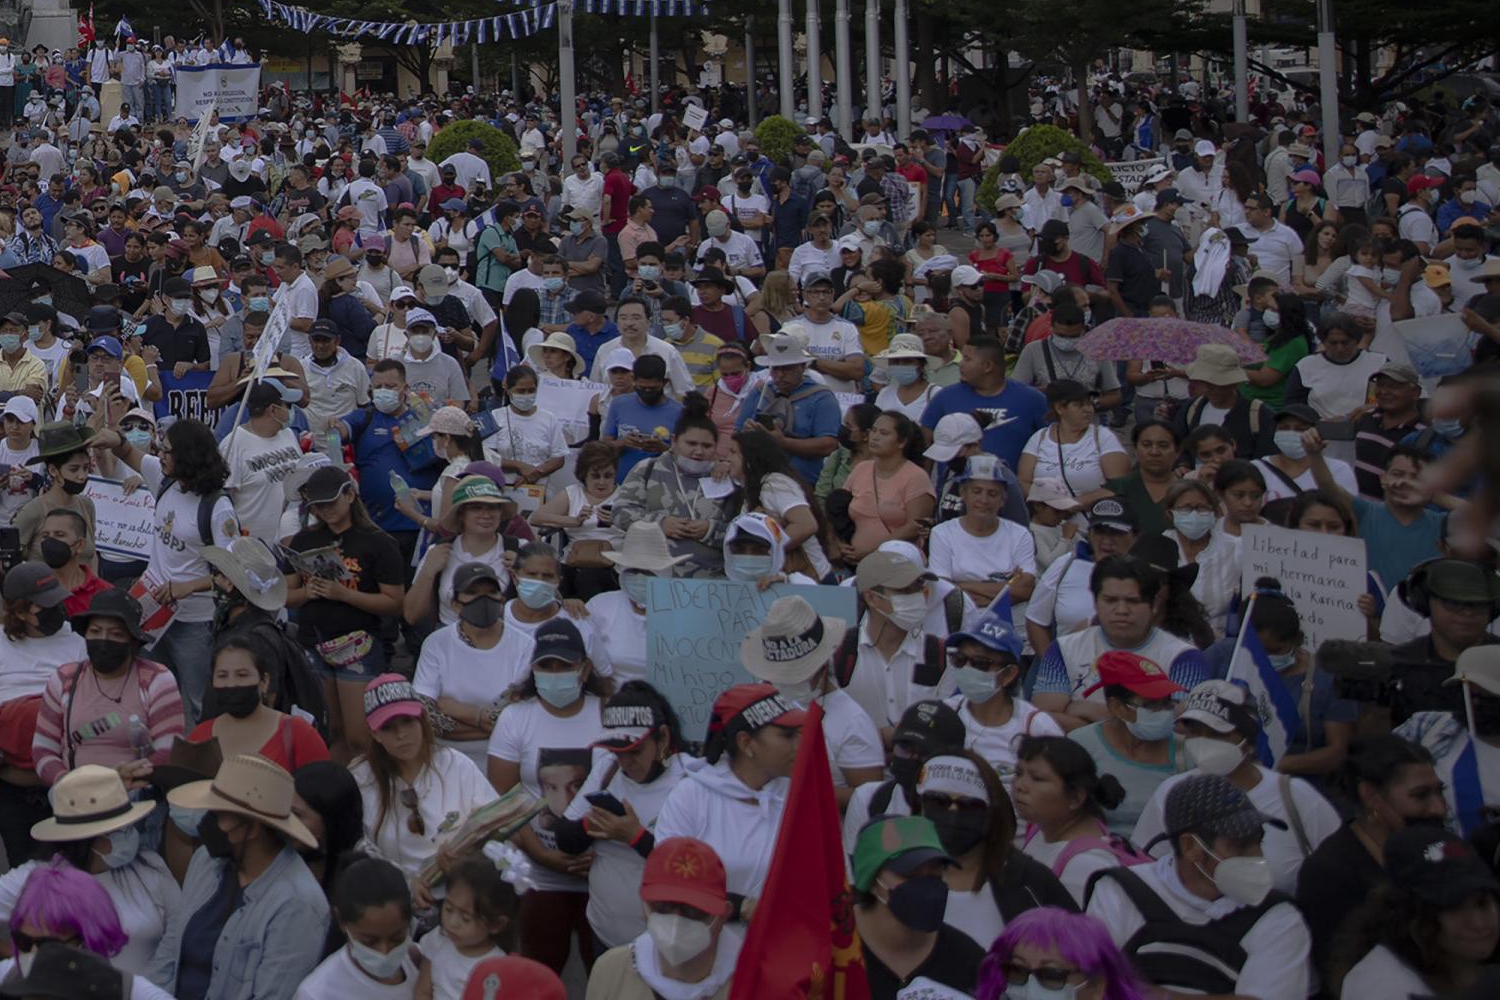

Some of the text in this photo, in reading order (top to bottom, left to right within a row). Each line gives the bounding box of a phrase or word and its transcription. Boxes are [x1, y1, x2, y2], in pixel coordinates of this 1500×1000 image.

[1111, 164, 1146, 172] LICTO
[1252, 535, 1359, 569] Libertad para
[1252, 562, 1269, 574] mi
[716, 608, 761, 635] PAR
[654, 631, 741, 661] INOCENT
